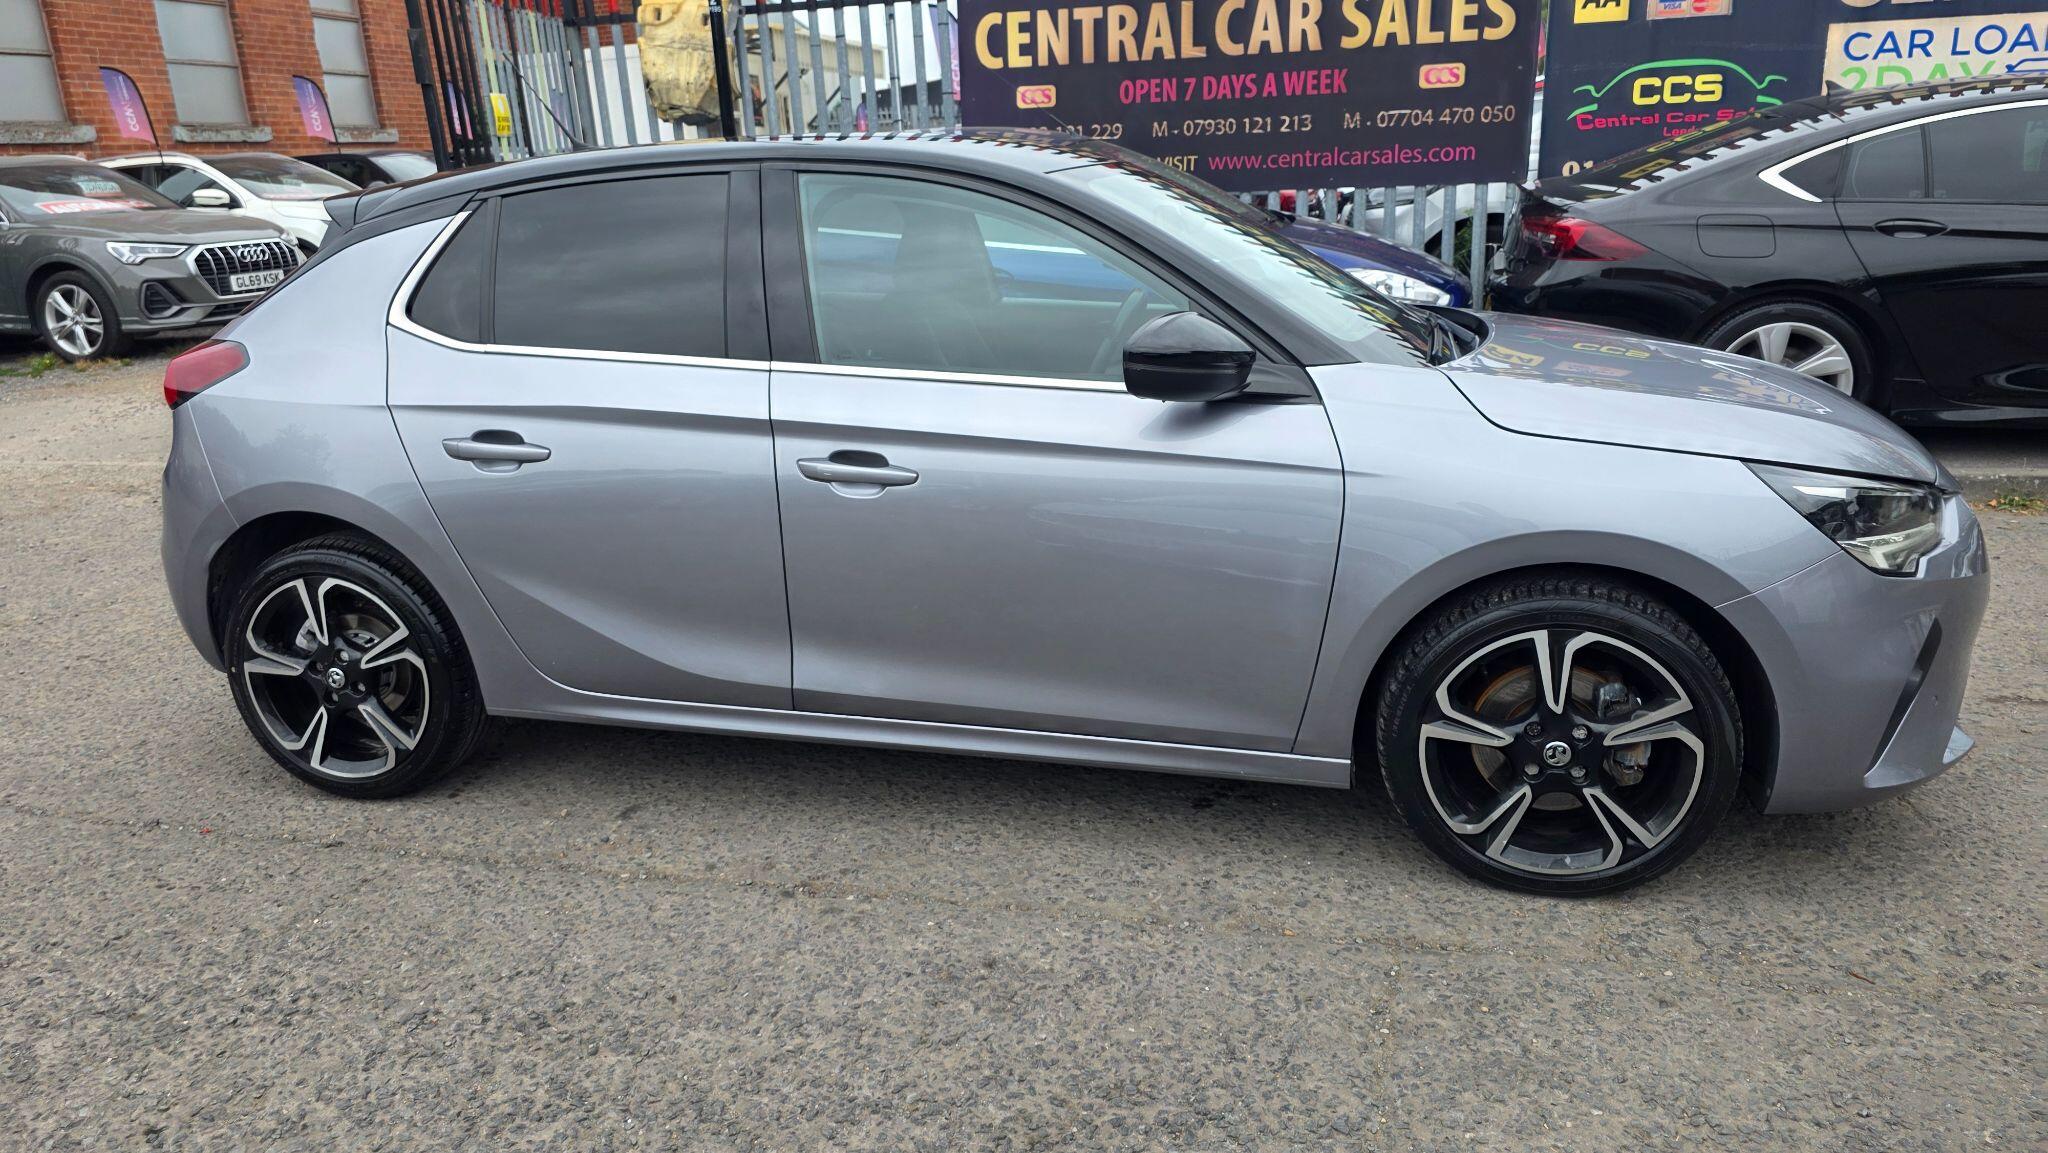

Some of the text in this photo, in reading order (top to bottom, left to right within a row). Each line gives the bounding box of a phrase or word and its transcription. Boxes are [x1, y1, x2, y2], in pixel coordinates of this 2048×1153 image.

[1663, 2, 1682, 10] VISA
[975, 0, 1517, 69] CENTRAL CAR SALES
[1843, 23, 2048, 61] CAR LOA
[1119, 68, 1348, 104] OPEN 7 DAYS A WEEK
[1424, 66, 1461, 85] CCS
[1020, 88, 1054, 105] CCS
[1632, 73, 1724, 106] CCS
[1152, 120, 1169, 137] M
[1183, 118, 1237, 137] 07930
[1243, 116, 1272, 134] 121
[1280, 114, 1312, 133] 213
[1343, 111, 1361, 129] M
[1377, 108, 1433, 128] 07704
[1439, 106, 1475, 125] 470
[1480, 104, 1515, 123] 050
[1576, 112, 1660, 130] Central
[1666, 112, 1710, 123] Car
[1091, 123, 1123, 140] 229
[1208, 144, 1476, 170] www.centralcarsales.com
[236, 272, 280, 288] GL69 KSK
